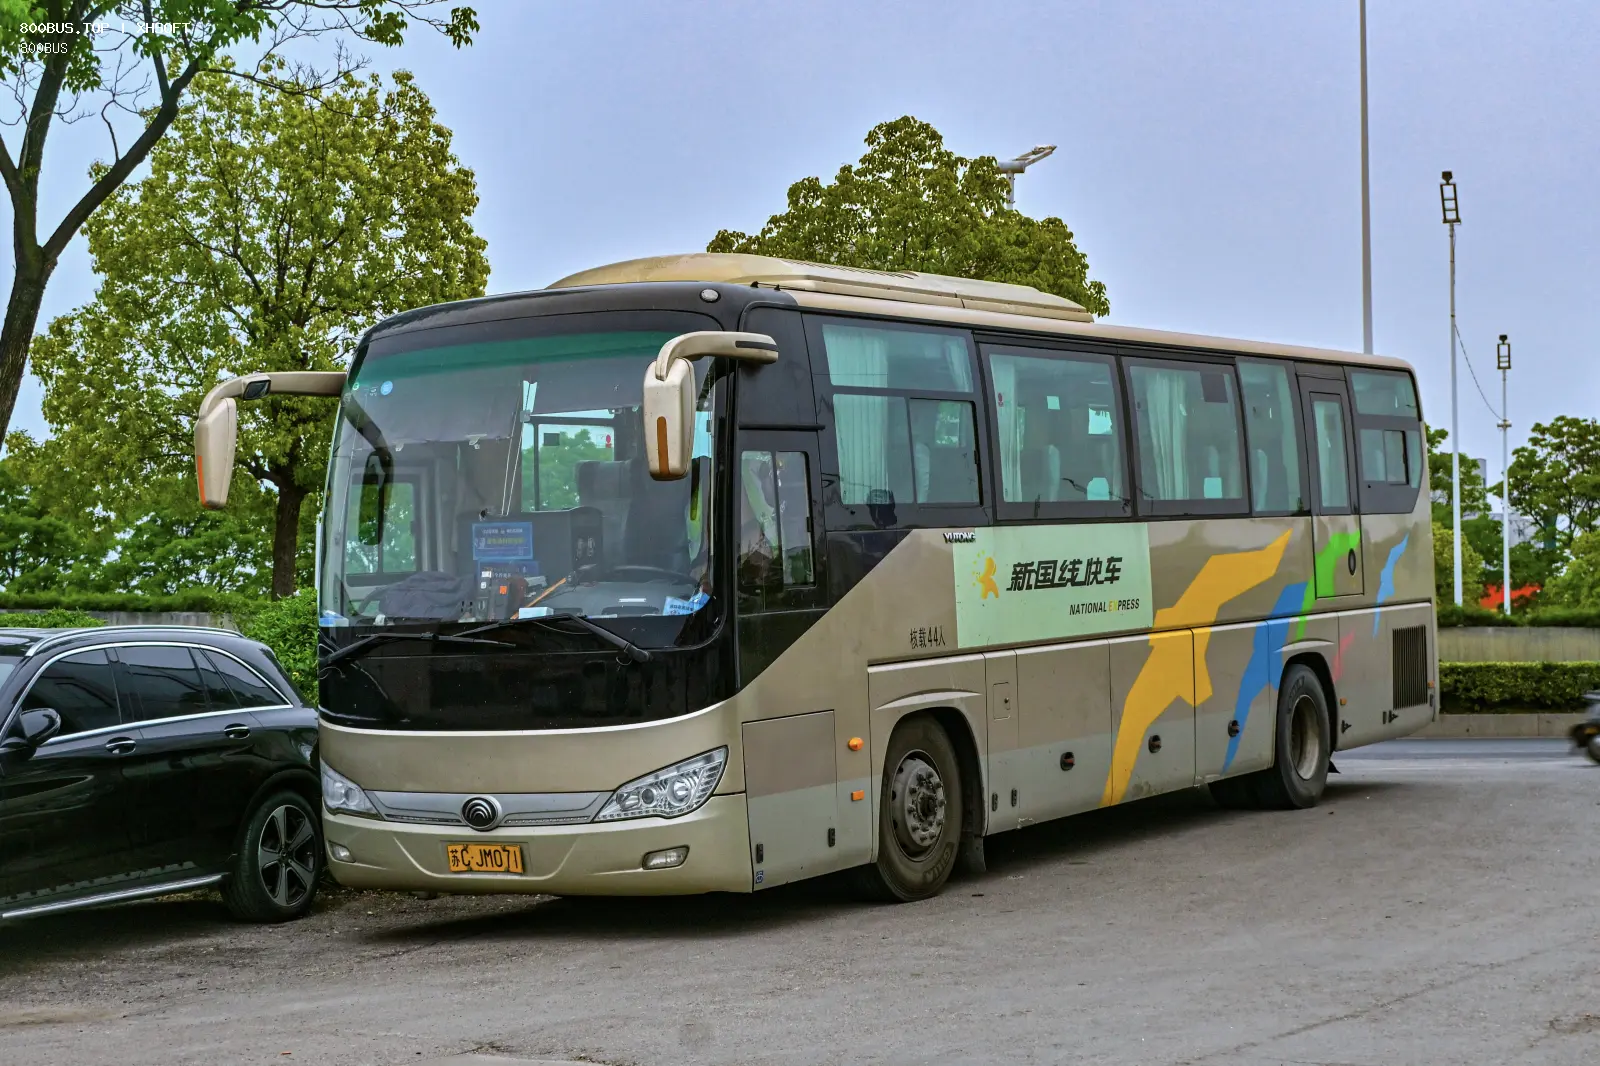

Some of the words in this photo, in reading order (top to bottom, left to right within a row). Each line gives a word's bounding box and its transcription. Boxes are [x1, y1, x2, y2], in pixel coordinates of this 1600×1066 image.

[943, 532, 976, 543] YUTONG
[1006, 556, 1123, 592] 新国线快车
[1069, 602, 1107, 616] NATIONAL
[1108, 598, 1140, 613] EXPRESS
